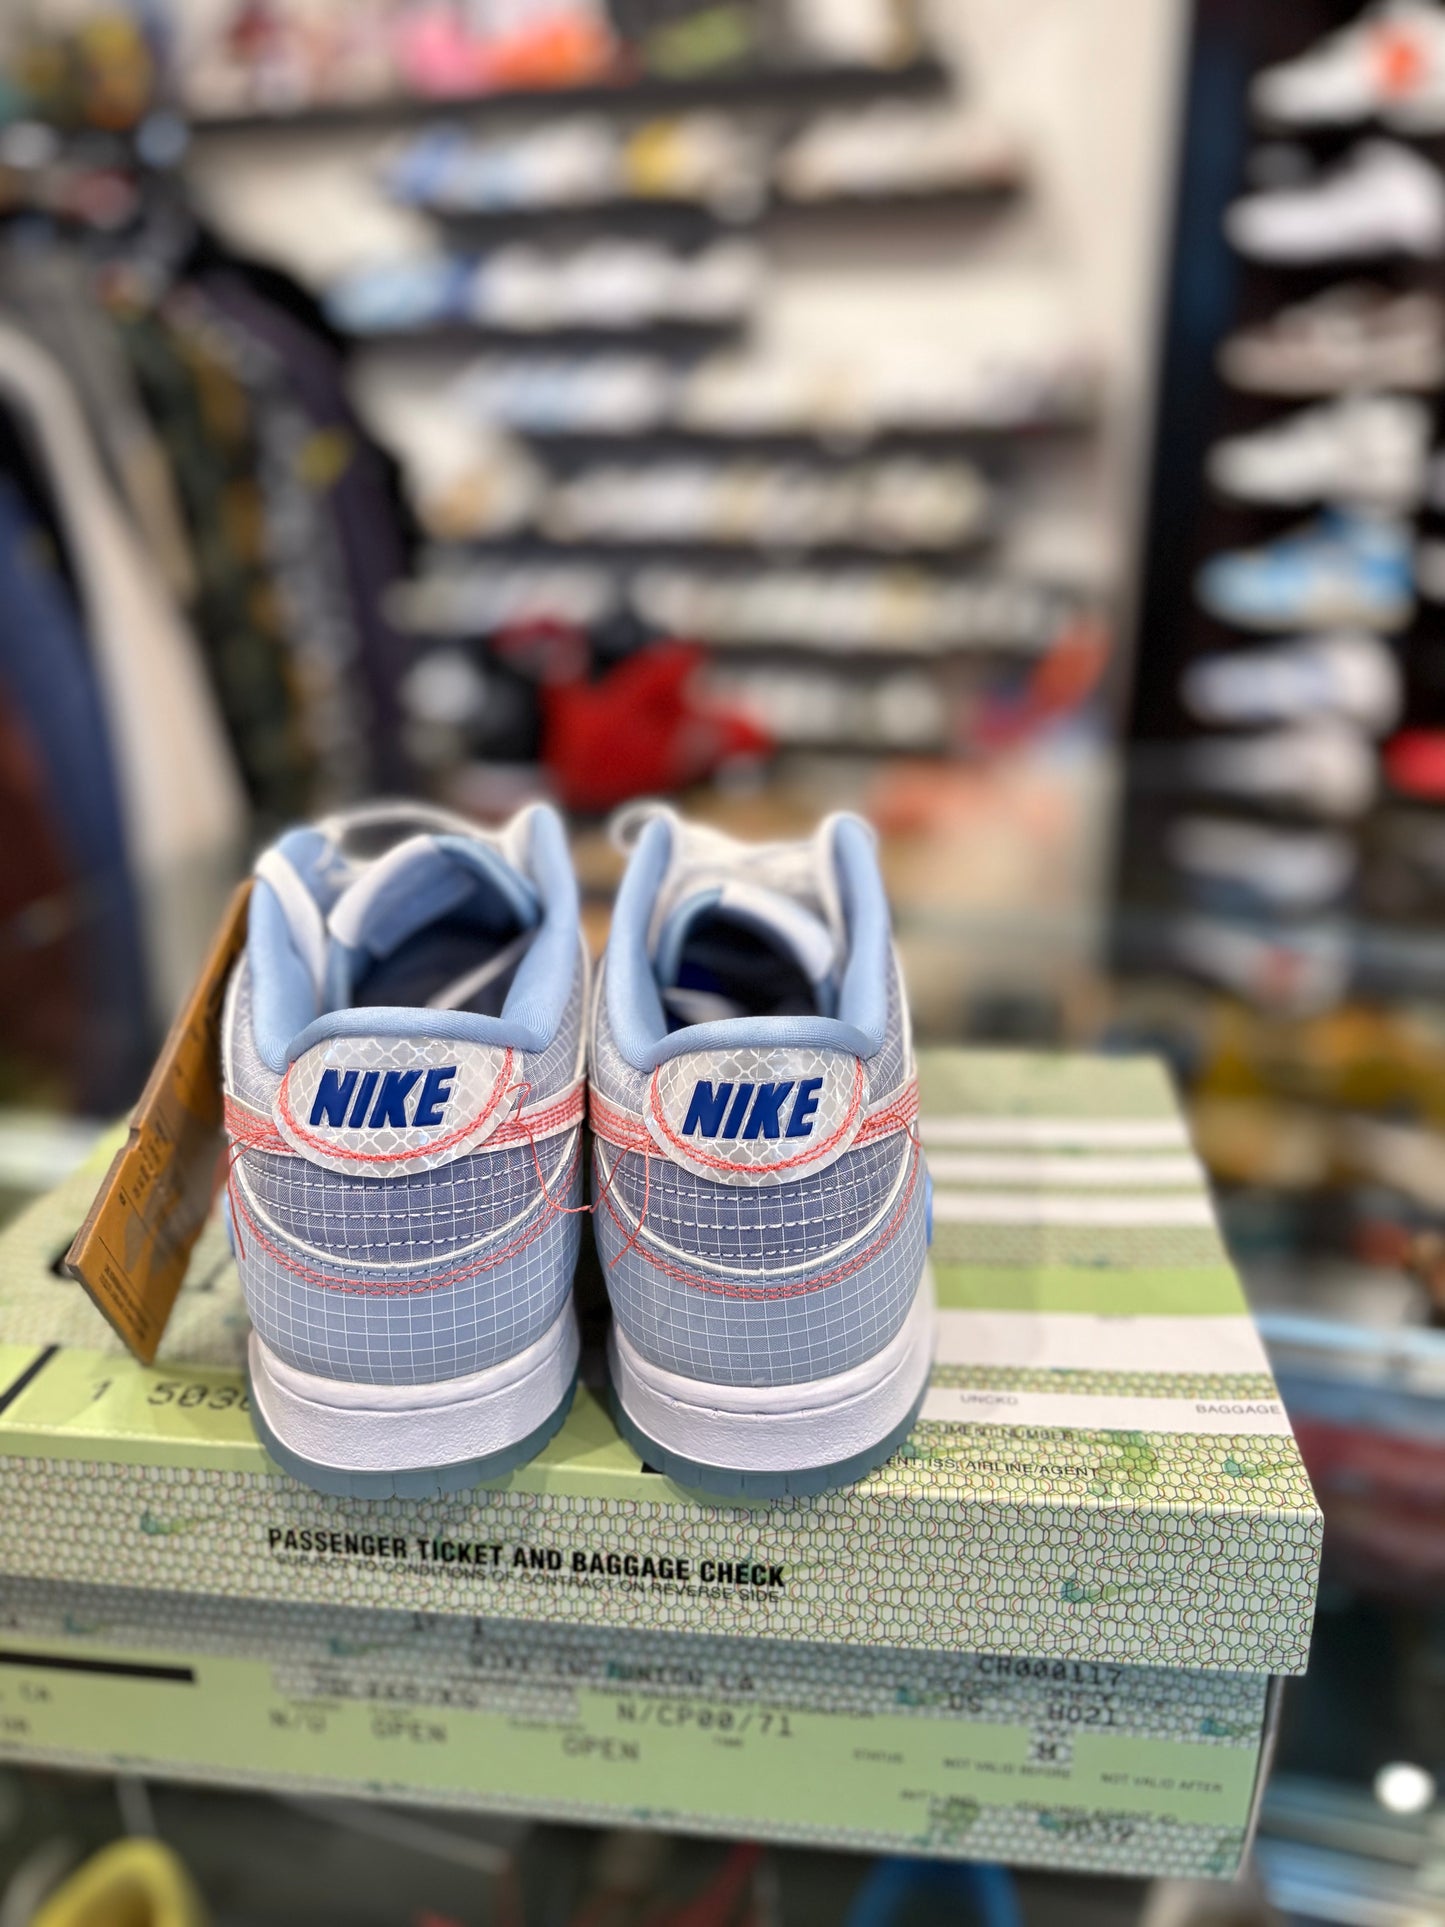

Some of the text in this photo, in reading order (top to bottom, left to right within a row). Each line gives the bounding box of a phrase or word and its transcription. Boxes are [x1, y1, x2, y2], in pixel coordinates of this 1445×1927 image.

[309, 1065, 457, 1129] NIKE
[681, 1076, 824, 1140] NIKE
[1195, 1404, 1281, 1415] BAGGAGE
[913, 1423, 994, 1438] OCUMENT
[886, 1456, 922, 1469] ENT.
[965, 1460, 1099, 1478] AIRLINE/AGENT
[268, 1528, 786, 1588] PASSENGER TICKET AND BAGGAGE CHECK
[275, 1552, 780, 1604] SUBJECT TO CONDITIONS OF CONTRACT ON REVERSE SIDE
[977, 1656, 1122, 1688] CR000117
[616, 1703, 794, 1738] N/CP00/71
[562, 1733, 640, 1763] OPEN
[942, 1758, 1072, 1780] NOT VALID BEFORE
[1101, 1771, 1223, 1794] NOT VALID AFTER
